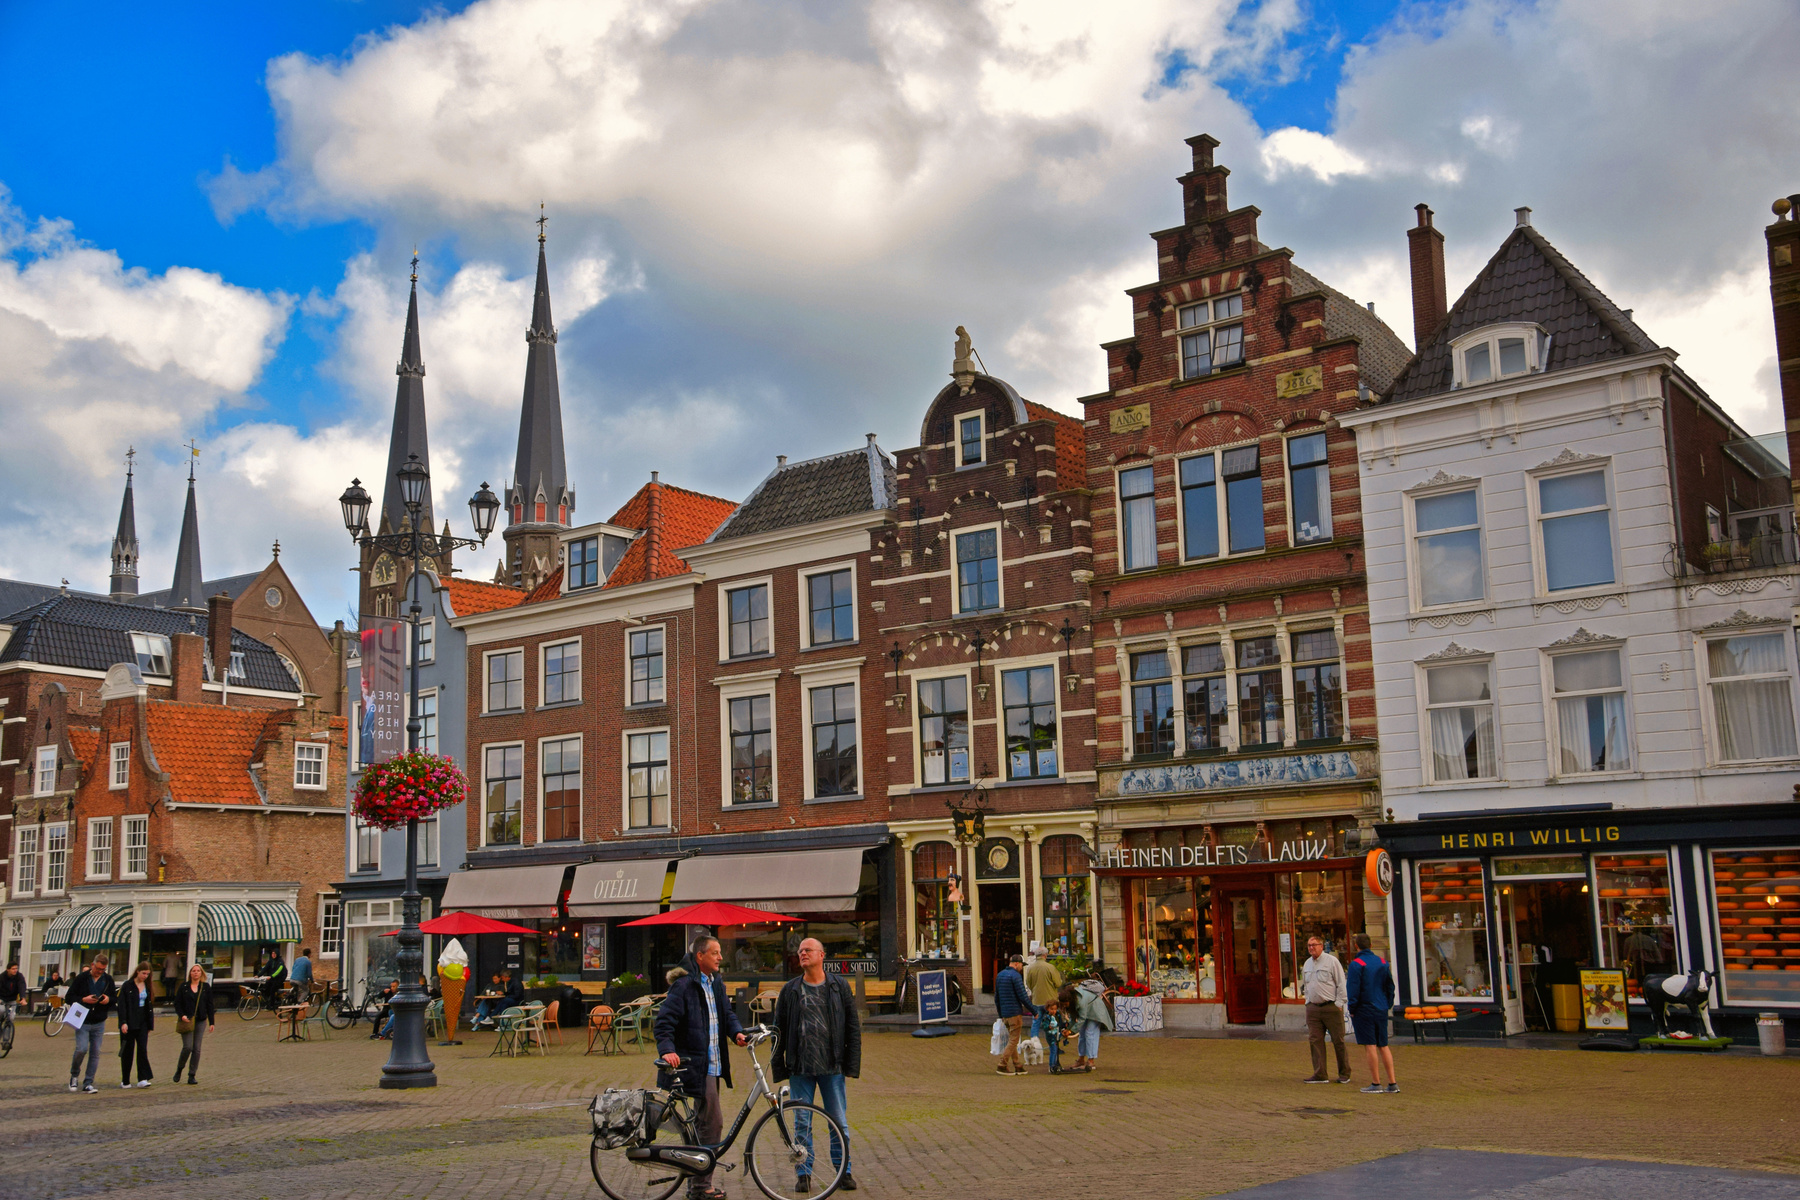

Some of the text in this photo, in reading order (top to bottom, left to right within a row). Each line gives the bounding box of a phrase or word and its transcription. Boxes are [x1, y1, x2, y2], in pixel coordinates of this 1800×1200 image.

[1285, 374, 1313, 390] 1886
[1116, 411, 1143, 426] ANNO
[1441, 826, 1621, 849] HENRI WILLIG
[1107, 846, 1174, 868] HEINEN
[1180, 844, 1248, 867] DELFTS
[594, 878, 638, 900] OTELLI
[481, 908, 519, 918] ESPRESSO BAR
[823, 962, 841, 973] EPIJS
[841, 961, 849, 974] &
